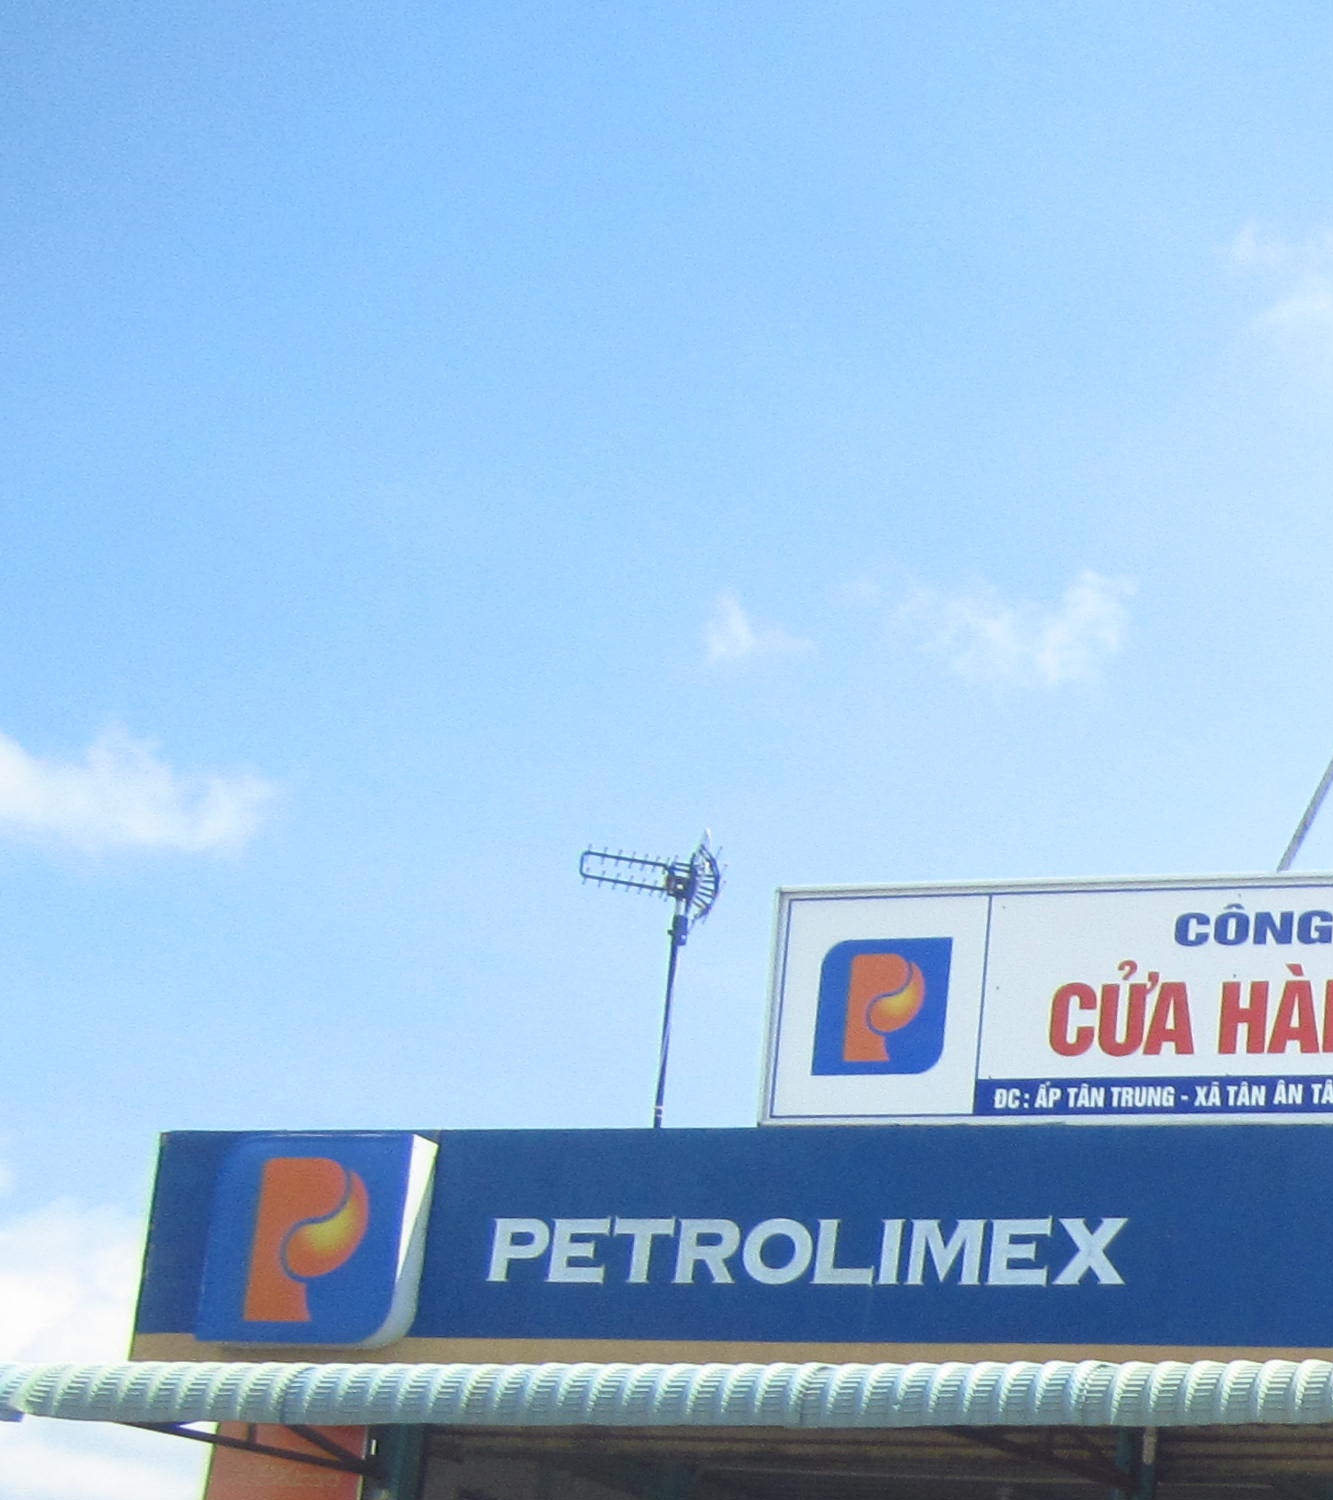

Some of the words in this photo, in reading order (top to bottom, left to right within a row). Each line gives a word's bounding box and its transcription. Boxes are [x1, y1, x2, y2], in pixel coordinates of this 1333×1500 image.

[1174, 903, 1333, 947] CÔNG
[1047, 960, 1194, 1056] CỬA
[1035, 1080, 1061, 1108] ẤP
[1067, 1080, 1104, 1108] TÂN
[1111, 1086, 1175, 1108] TRUNG
[1194, 1080, 1220, 1107] XÃ
[1227, 1080, 1266, 1107] TÂN
[1273, 1079, 1303, 1106] ÂN
[485, 1214, 1130, 1287] PETROLIMEX
